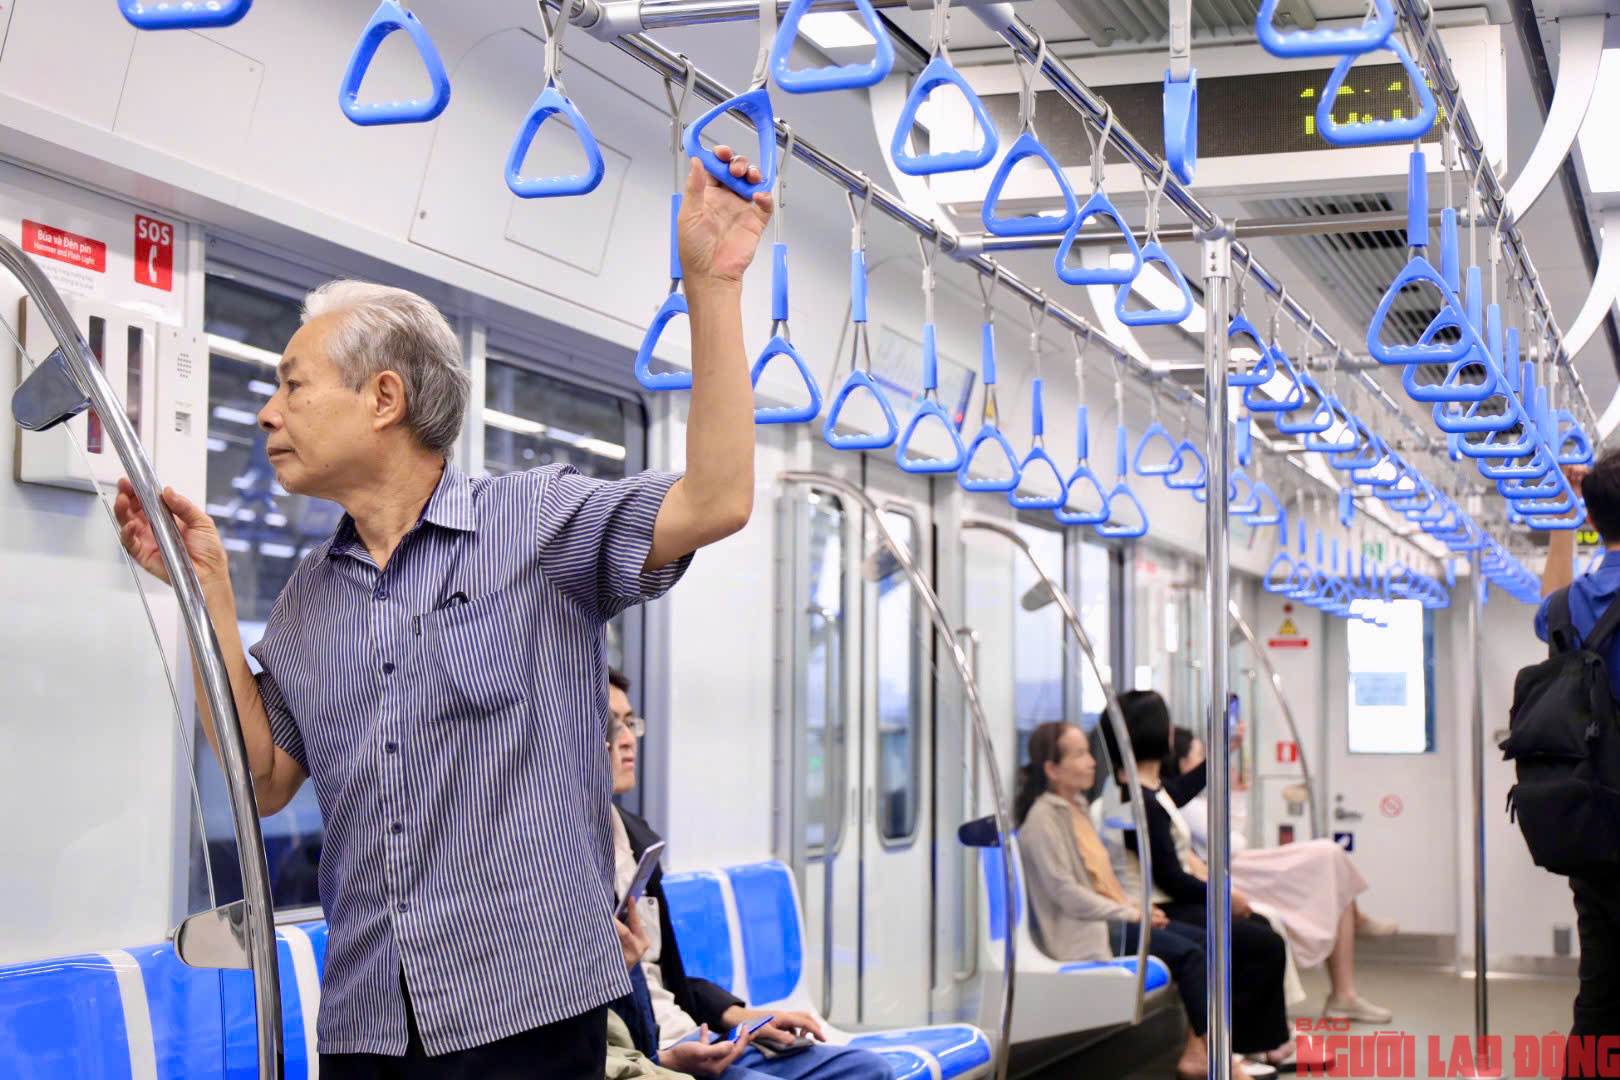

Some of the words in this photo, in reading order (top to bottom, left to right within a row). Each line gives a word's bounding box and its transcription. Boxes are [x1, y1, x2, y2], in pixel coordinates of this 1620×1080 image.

[37, 228, 52, 243] Búa
[53, 234, 62, 245] và
[63, 236, 79, 250] Đèn
[80, 243, 92, 255] pin
[138, 218, 170, 246] SOS
[57, 248, 67, 257] and
